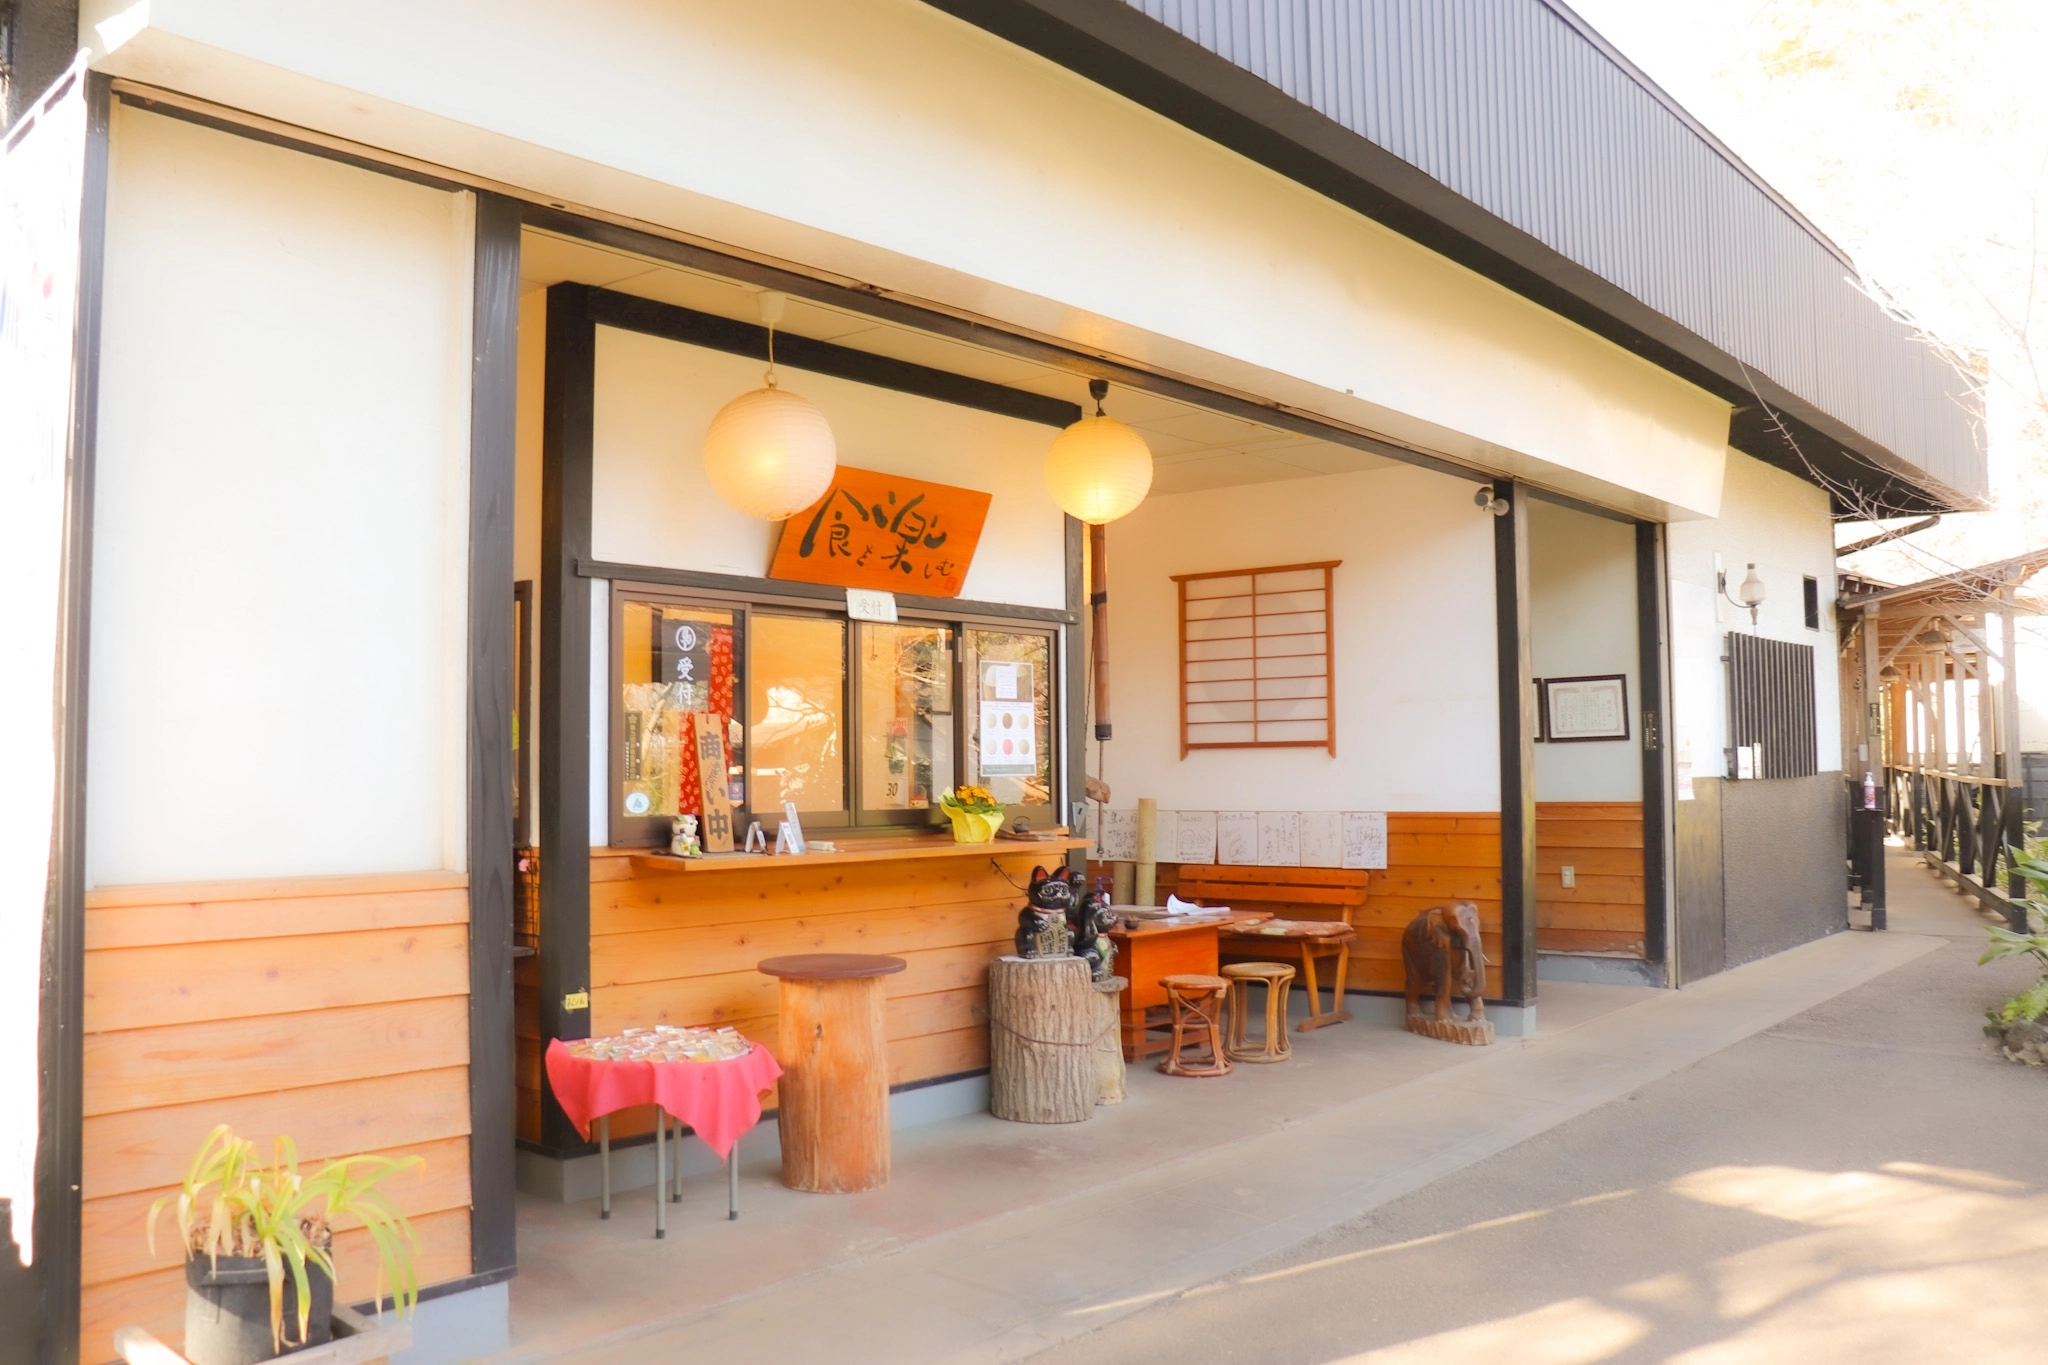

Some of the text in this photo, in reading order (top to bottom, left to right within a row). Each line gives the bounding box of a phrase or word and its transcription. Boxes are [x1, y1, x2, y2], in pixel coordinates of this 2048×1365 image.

[799, 487, 954, 580] 食を楽しむ
[859, 598, 884, 616] 受付
[676, 656, 695, 705] 受付
[699, 731, 729, 840] 商い中
